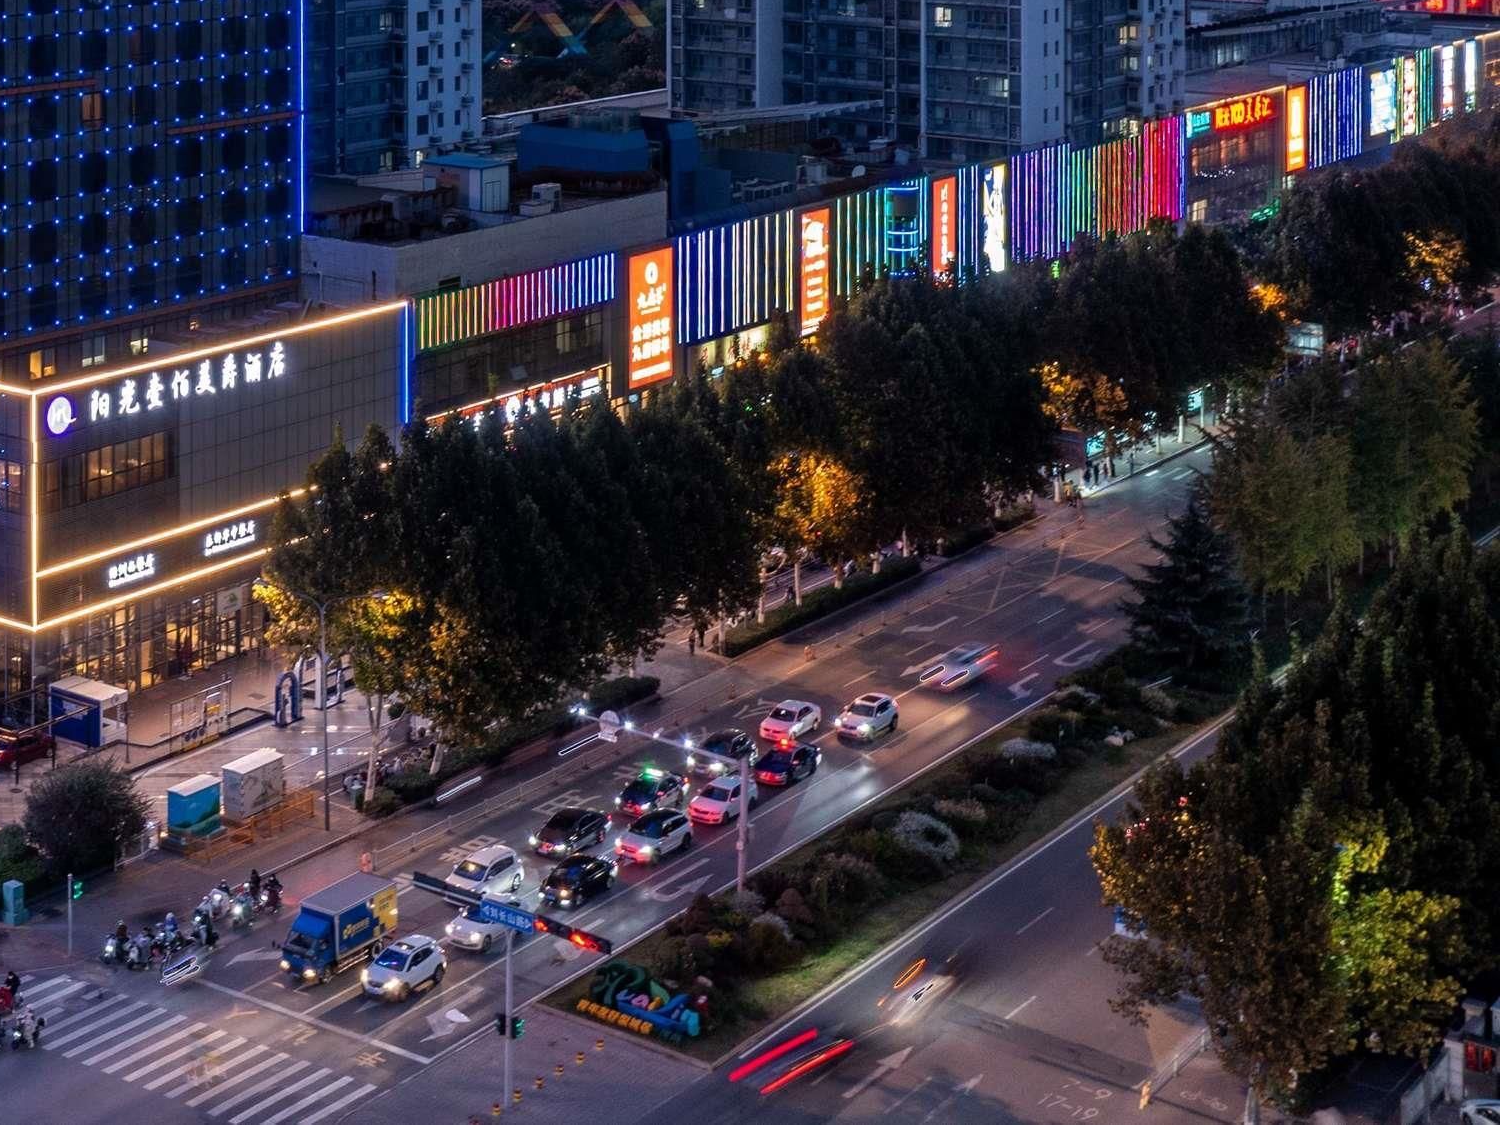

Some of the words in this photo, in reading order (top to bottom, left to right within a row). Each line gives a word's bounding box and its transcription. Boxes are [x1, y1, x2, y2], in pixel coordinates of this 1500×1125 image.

[90, 342, 286, 421] 阳光壹佰美爵酒店
